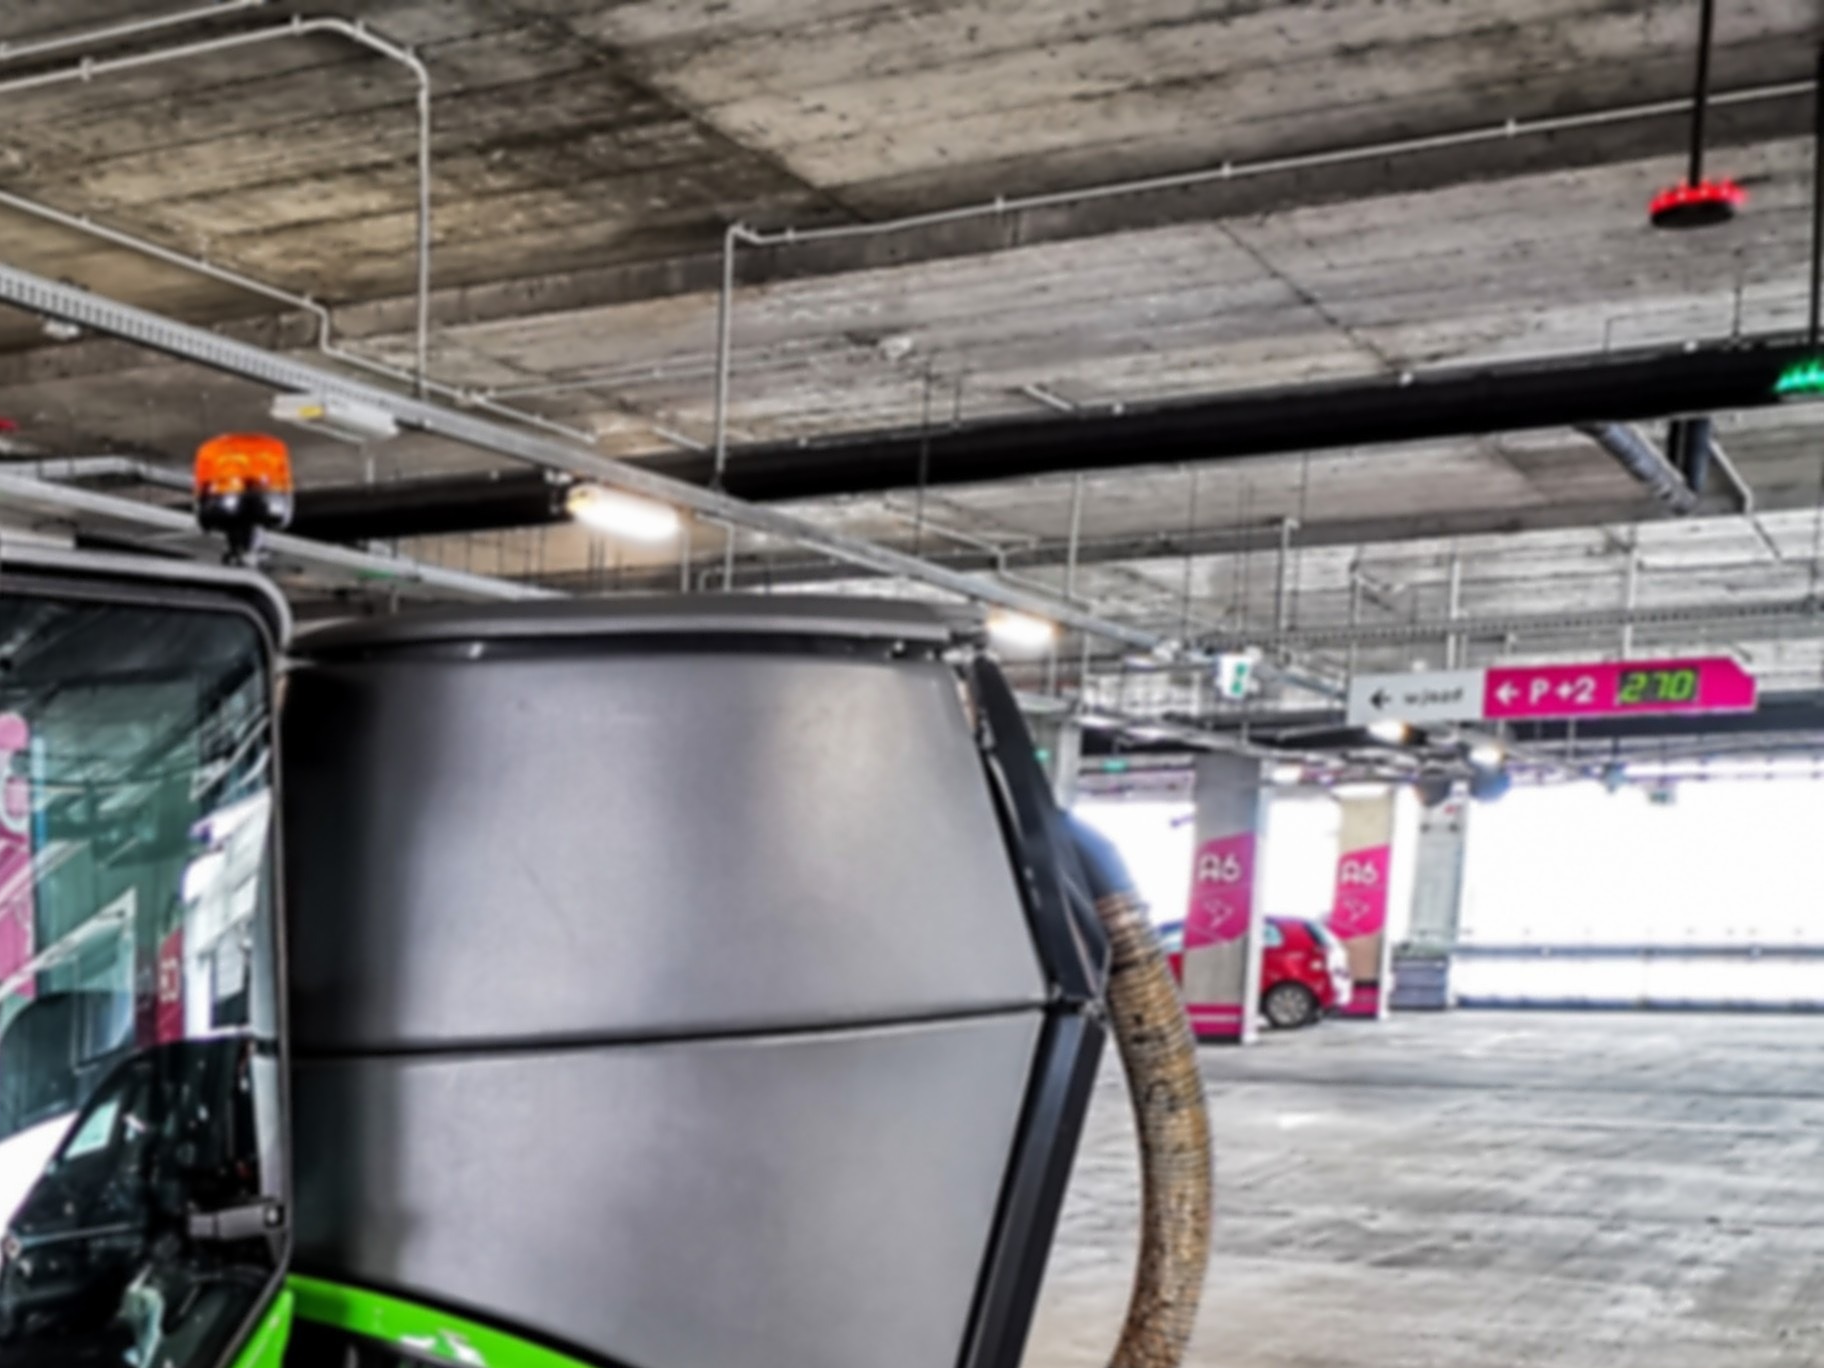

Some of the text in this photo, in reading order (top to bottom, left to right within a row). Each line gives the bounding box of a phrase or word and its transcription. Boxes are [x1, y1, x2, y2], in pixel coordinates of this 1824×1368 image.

[1529, 680, 1550, 704] P
[1619, 669, 1695, 704] 270
[1197, 853, 1241, 883] A6
[1340, 859, 1378, 885] A6
